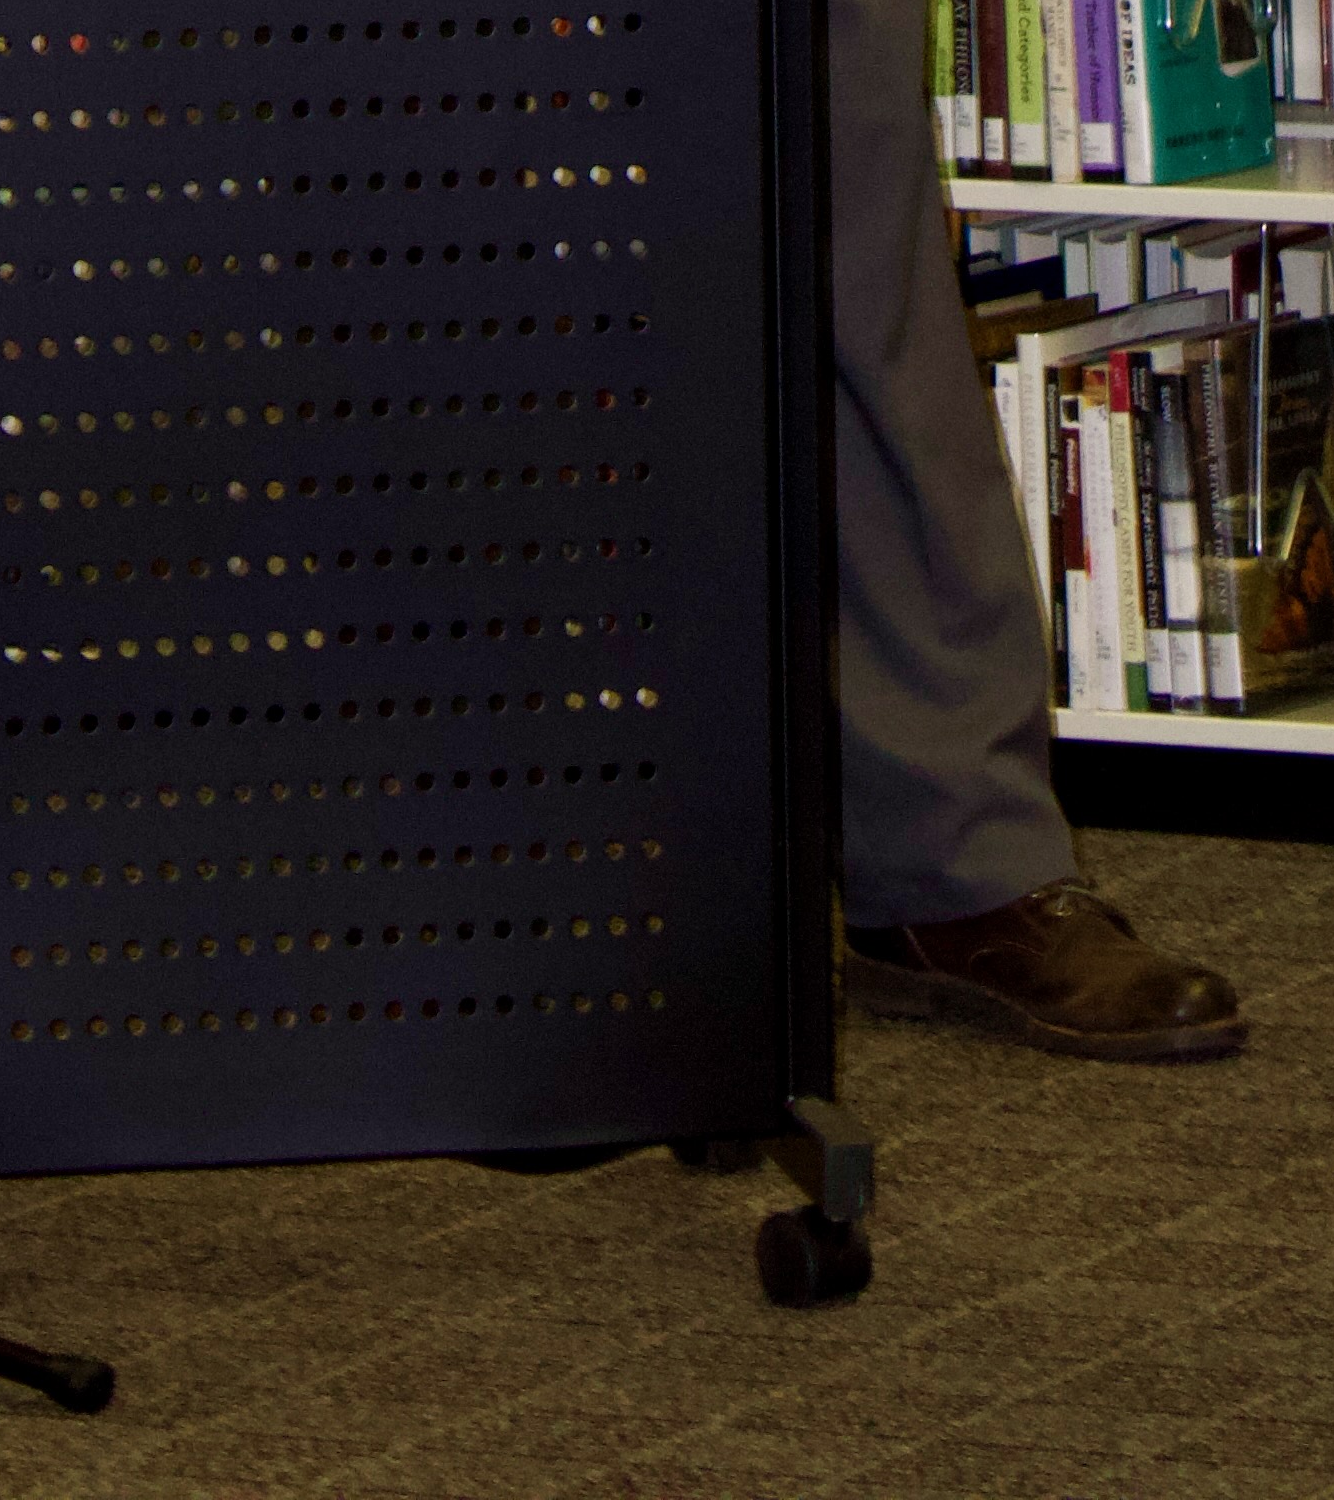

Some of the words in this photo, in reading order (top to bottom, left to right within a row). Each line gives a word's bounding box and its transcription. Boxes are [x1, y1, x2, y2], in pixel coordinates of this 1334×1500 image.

[1118, 0, 1132, 24] OF
[1015, 17, 1032, 103] Categories
[1120, 30, 1136, 85] IDEAS
